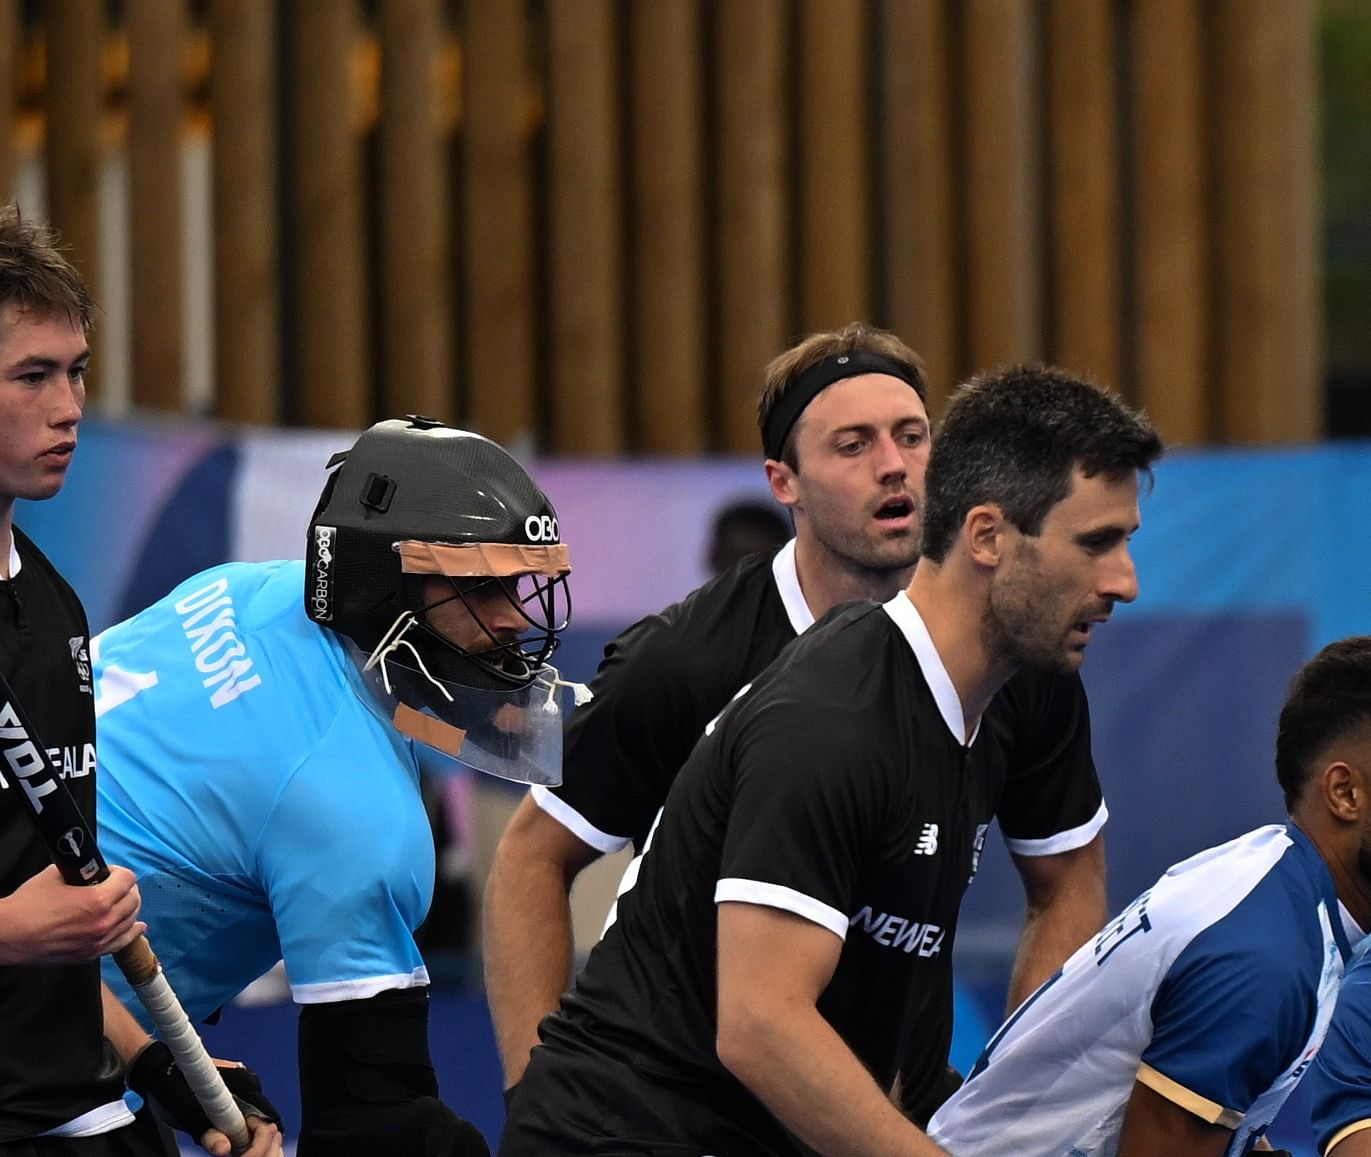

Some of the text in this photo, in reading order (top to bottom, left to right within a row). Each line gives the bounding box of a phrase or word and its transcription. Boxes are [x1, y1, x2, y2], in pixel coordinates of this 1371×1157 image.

[525, 515, 559, 541] OBO
[313, 560, 333, 621] CARBON
[175, 577, 262, 709] DIXON
